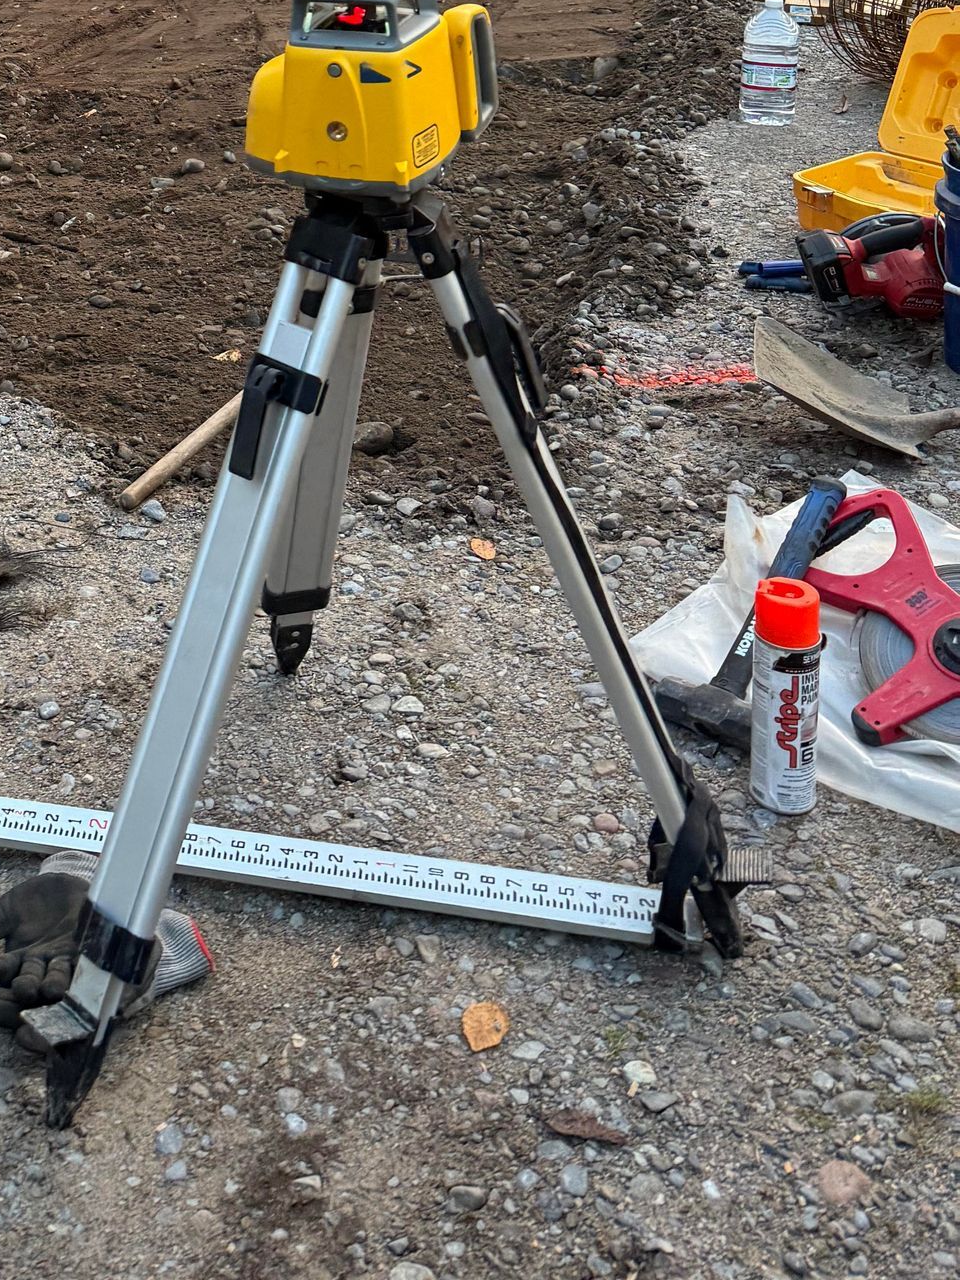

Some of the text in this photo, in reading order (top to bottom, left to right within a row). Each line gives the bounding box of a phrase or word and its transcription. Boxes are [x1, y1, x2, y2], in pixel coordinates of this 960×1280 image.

[774, 675, 801, 769] stripe
[1, 808, 15, 816] 4
[23, 810, 37, 819] 3
[45, 813, 60, 822] 2
[89, 818, 108, 830] 2
[185, 833, 198, 842] 8
[208, 836, 222, 844] 7
[231, 840, 246, 849] 6
[255, 843, 270, 852] 5
[280, 847, 295, 856] 4
[304, 850, 319, 859] 3
[328, 854, 343, 863] 2
[403, 864, 419, 874] 11
[428, 867, 444, 877] 10
[454, 871, 469, 880] 9
[480, 875, 495, 884] 8
[506, 878, 522, 888] 7
[532, 882, 548, 892] 6
[558, 886, 575, 896] 5
[585, 891, 602, 900] 4
[612, 894, 628, 904] 3
[639, 897, 656, 908] 2
